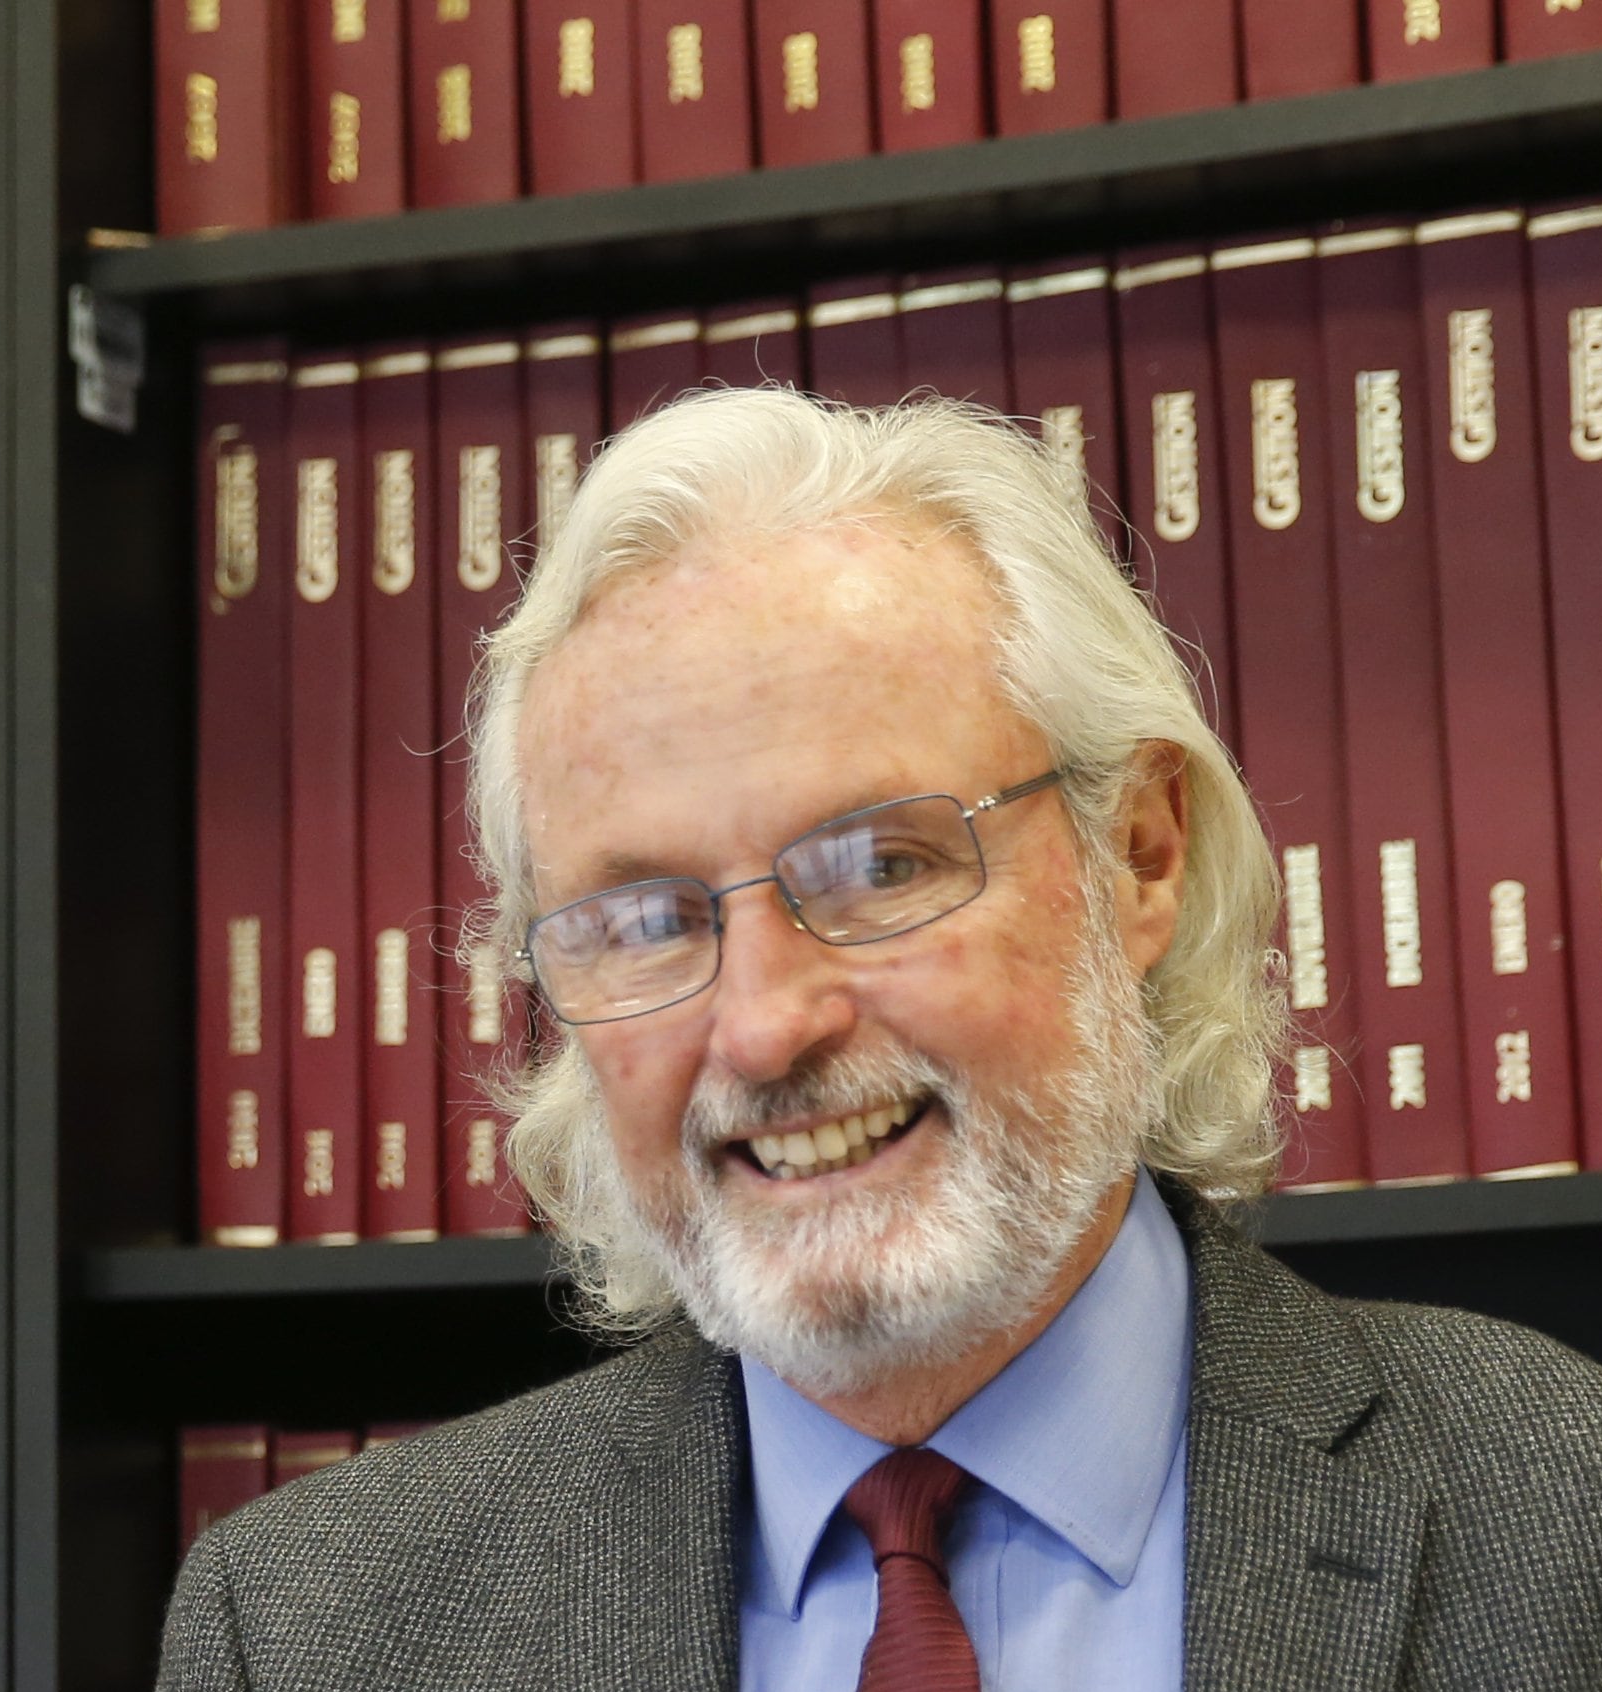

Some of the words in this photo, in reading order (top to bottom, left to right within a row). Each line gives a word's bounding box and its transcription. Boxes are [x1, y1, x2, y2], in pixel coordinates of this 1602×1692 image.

[1489, 879, 1529, 975] ENERO
[1387, 1043, 1427, 1111] 2011
[1495, 1030, 1532, 1104] 2012
